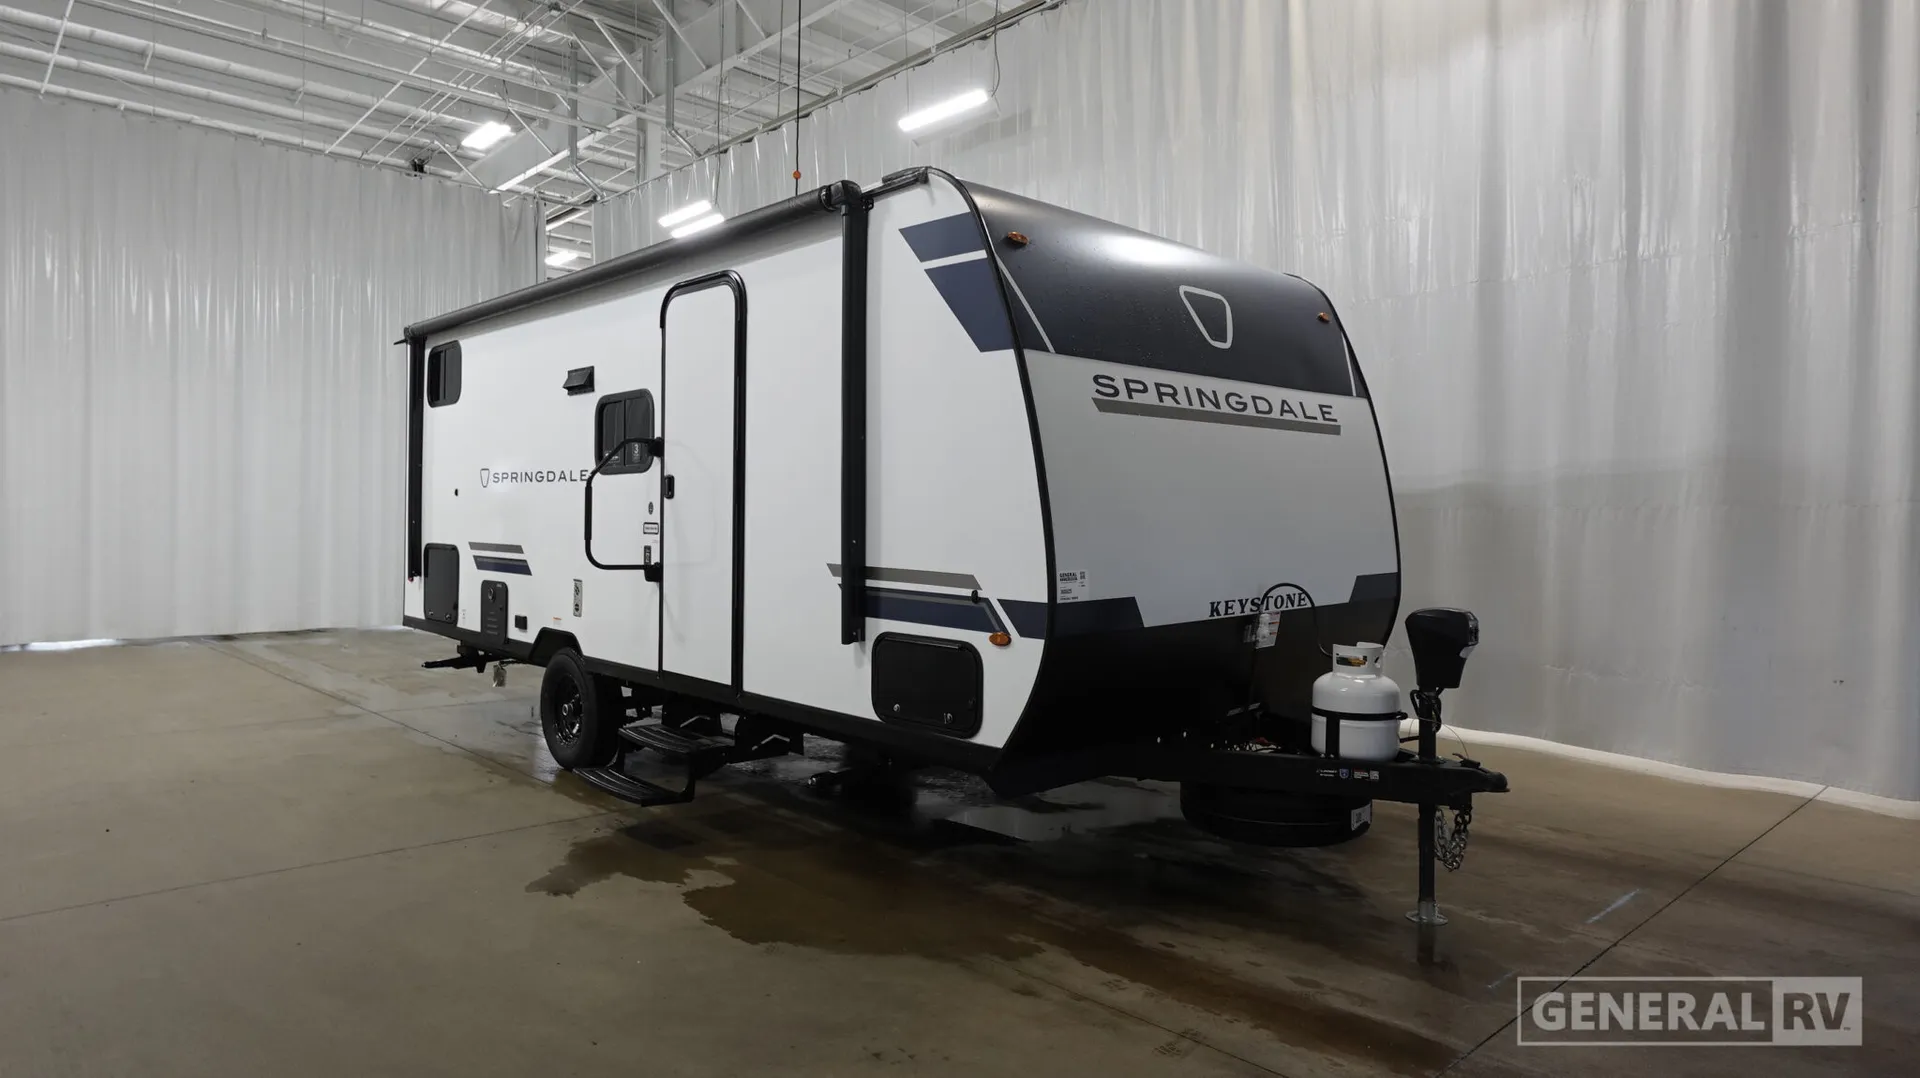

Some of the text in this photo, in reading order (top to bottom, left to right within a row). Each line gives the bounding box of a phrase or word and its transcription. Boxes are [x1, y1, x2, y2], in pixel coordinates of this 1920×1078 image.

[1092, 374, 1338, 423] SPRINGDALE
[492, 469, 589, 484] SPRINGDALE
[1209, 593, 1308, 618] KEYSTONE
